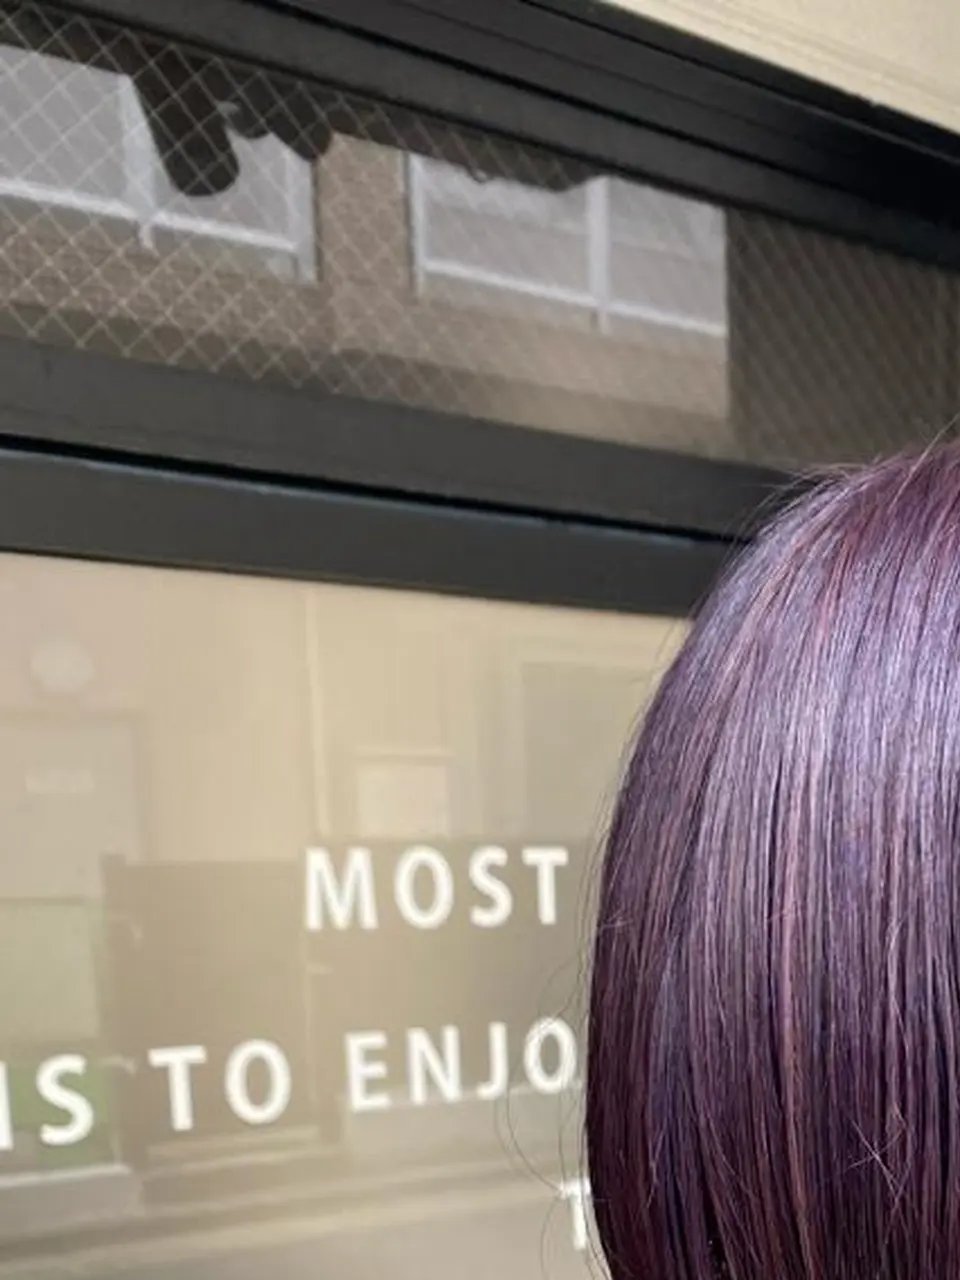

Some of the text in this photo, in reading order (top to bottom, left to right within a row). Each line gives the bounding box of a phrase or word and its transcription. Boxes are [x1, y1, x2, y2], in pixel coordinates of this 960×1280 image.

[305, 847, 569, 931] MOST
[149, 1031, 291, 1131] TO
[345, 1017, 580, 1112] ENJO
